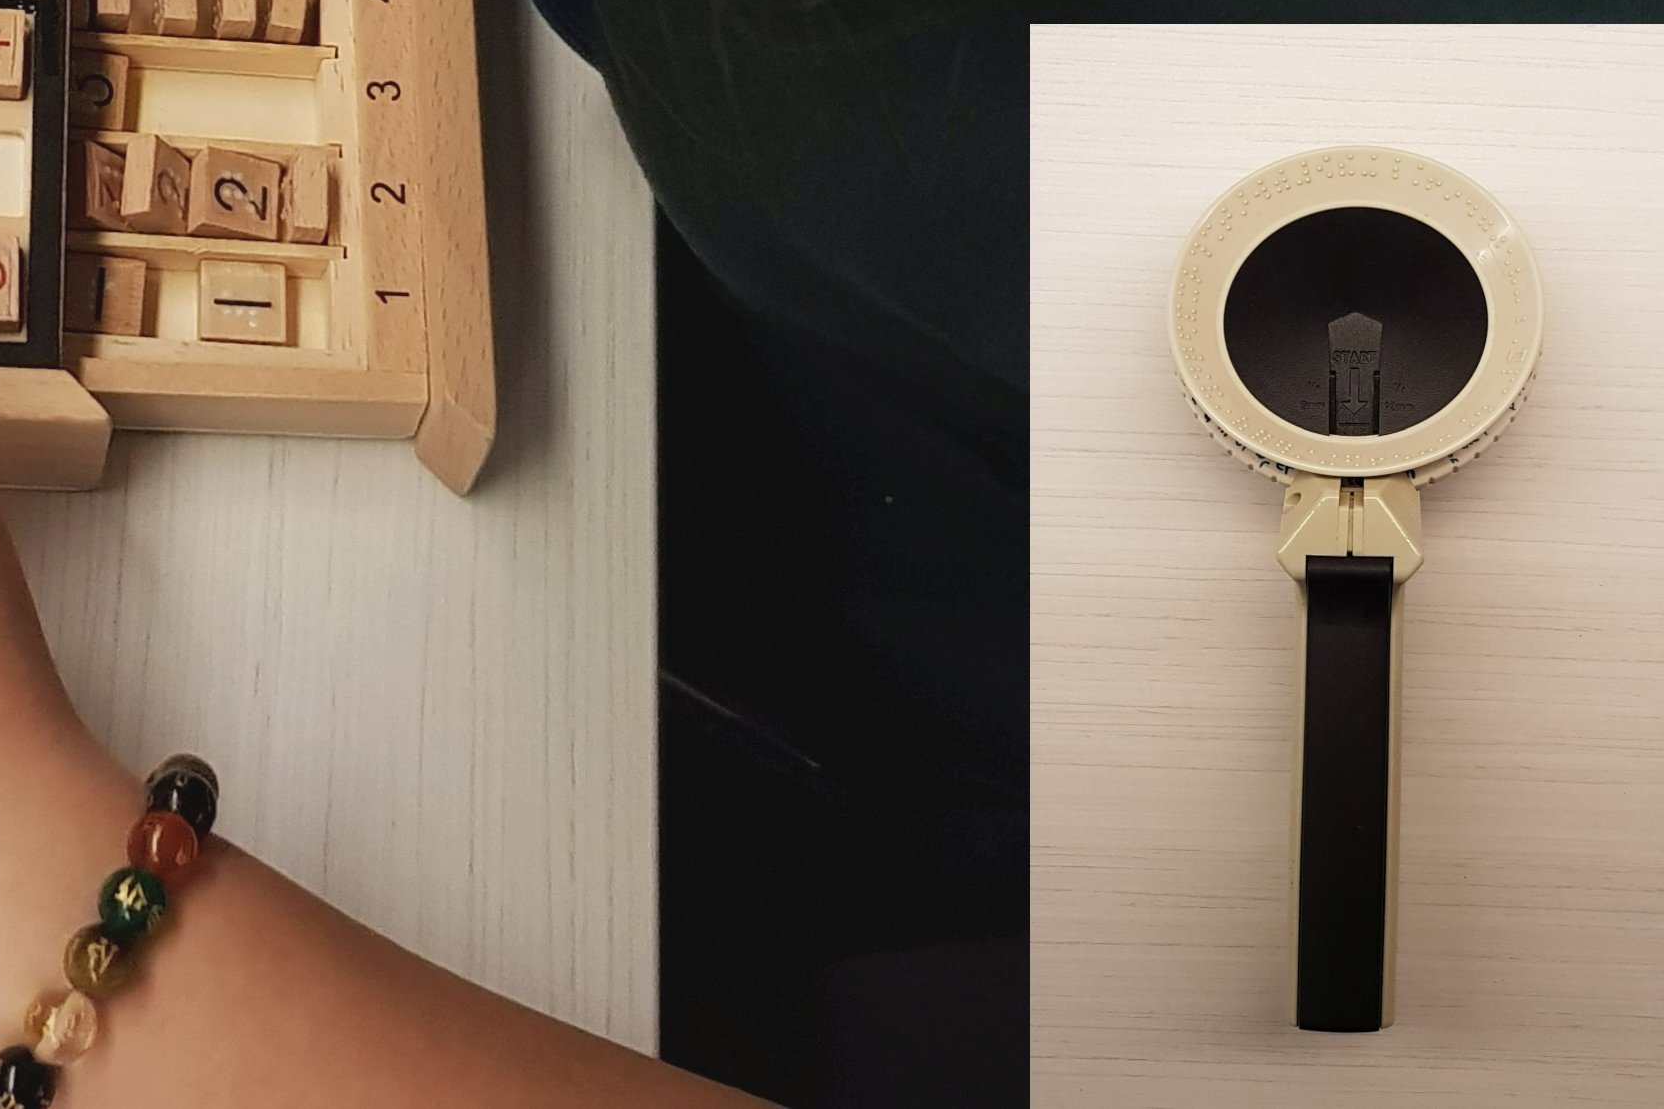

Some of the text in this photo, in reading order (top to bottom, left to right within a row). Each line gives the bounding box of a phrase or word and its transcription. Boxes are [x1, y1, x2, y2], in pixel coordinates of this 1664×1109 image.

[366, 80, 401, 101] 3
[214, 177, 268, 221] 2
[370, 182, 406, 205] 2
[375, 290, 410, 304] 1
[1332, 350, 1378, 365] START
